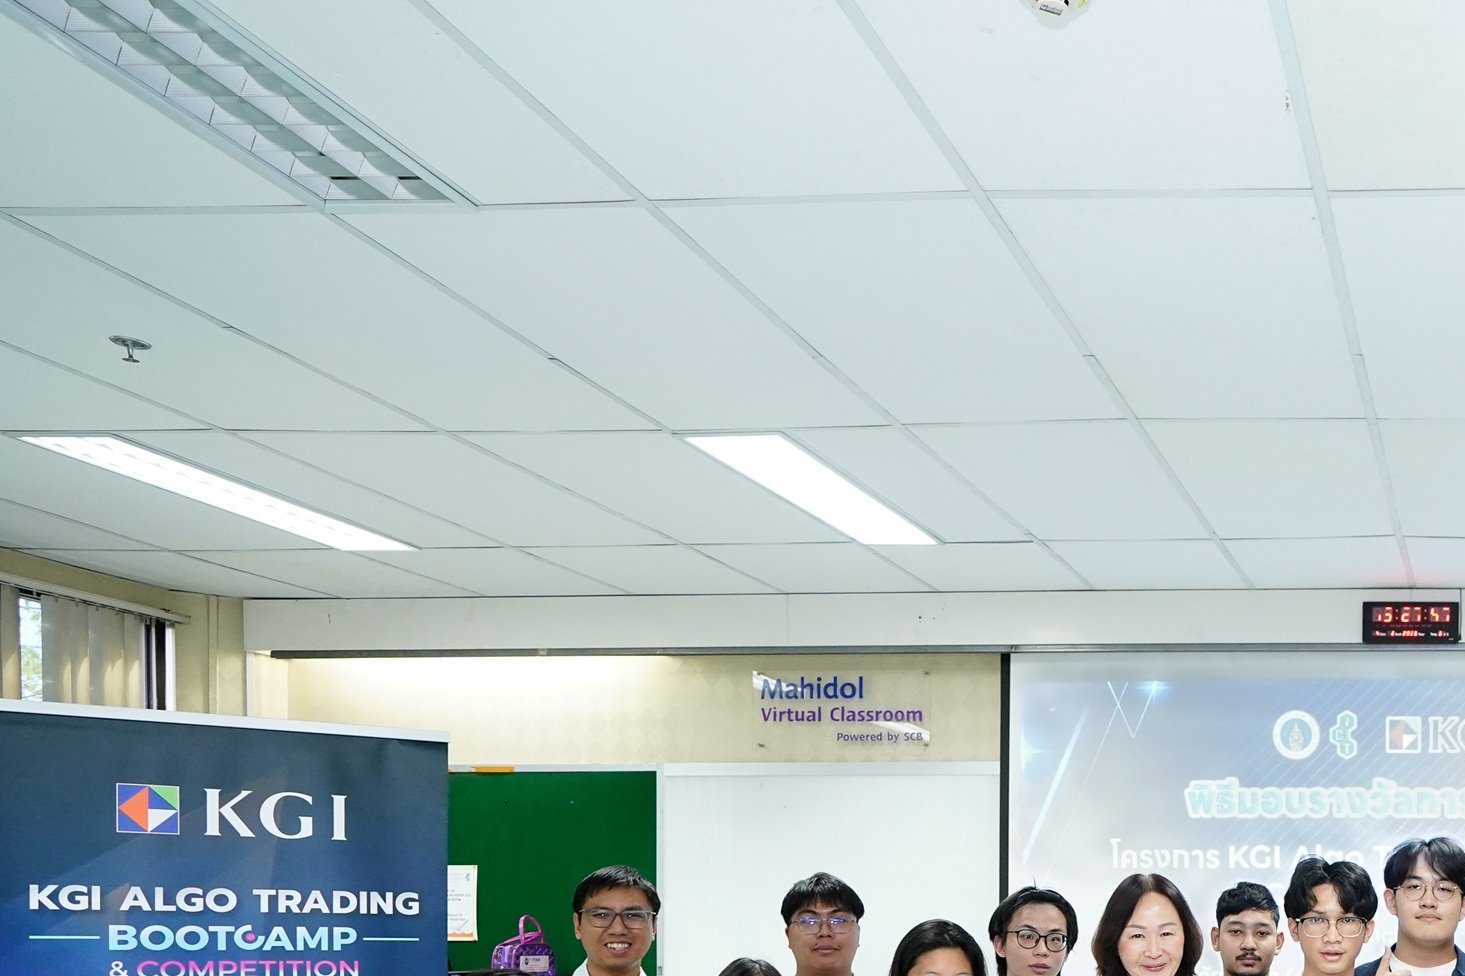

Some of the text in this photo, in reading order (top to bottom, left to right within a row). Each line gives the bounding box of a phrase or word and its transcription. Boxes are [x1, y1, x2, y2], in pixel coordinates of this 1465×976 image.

[761, 676, 864, 699] Mahidol
[761, 706, 923, 722] Virtual Classroom
[837, 732, 923, 743] Powered by SCB
[204, 788, 347, 841] KGI
[1110, 838, 1220, 869] โครงการ
[1229, 845, 1280, 869] KGI
[29, 884, 100, 911] KGI
[120, 886, 237, 912] ALGO
[253, 888, 420, 916] TRADING
[108, 924, 357, 951] BOOTCAMP
